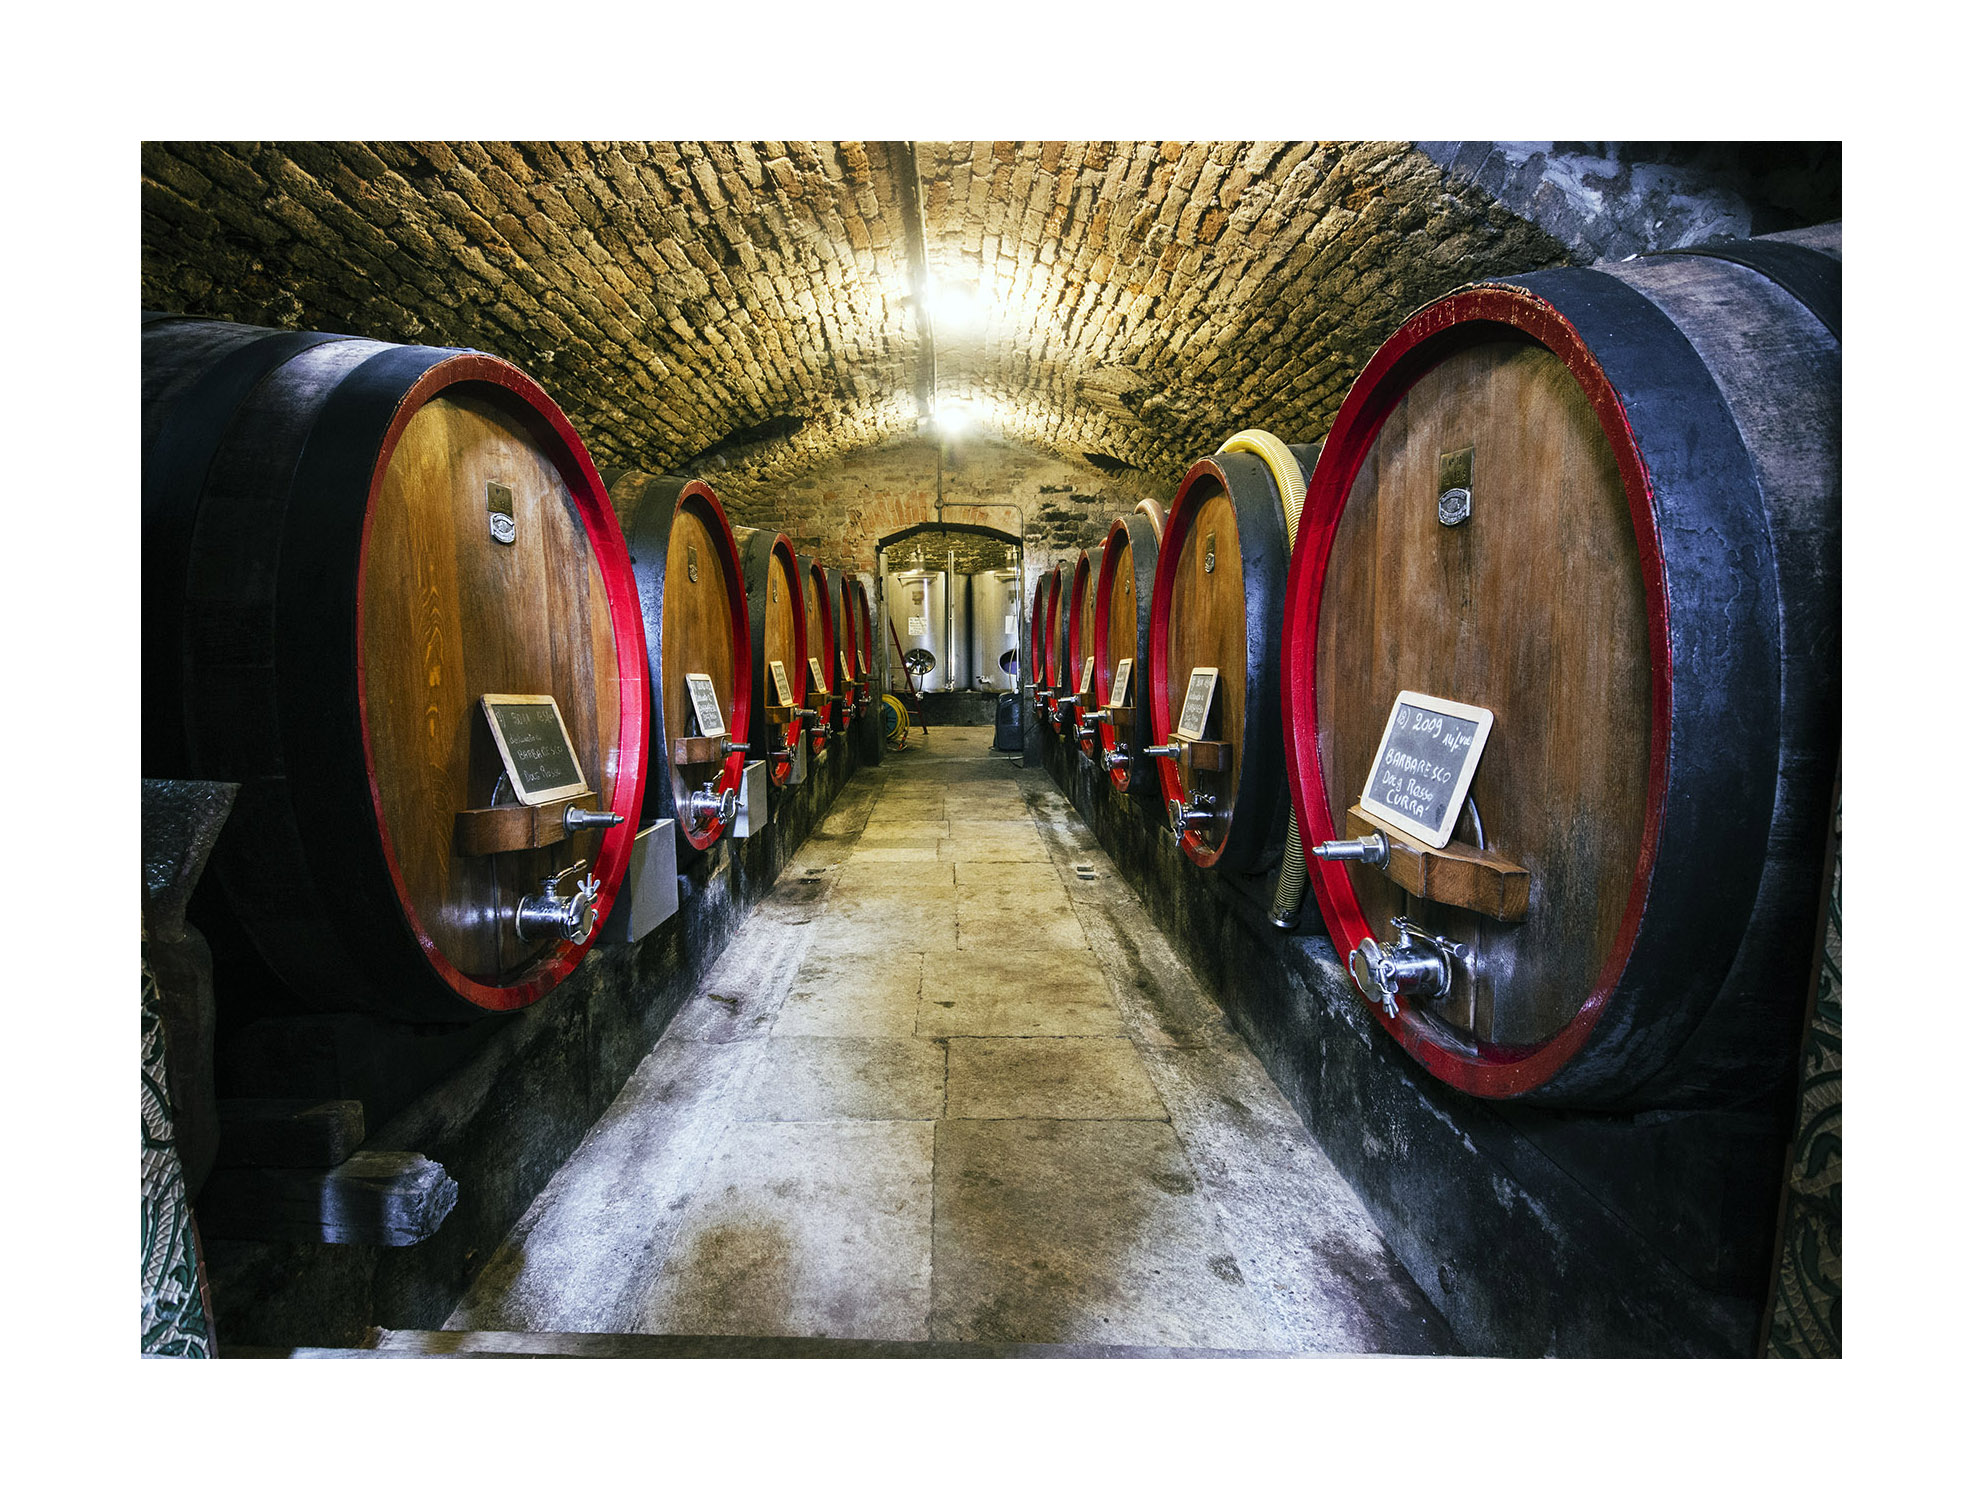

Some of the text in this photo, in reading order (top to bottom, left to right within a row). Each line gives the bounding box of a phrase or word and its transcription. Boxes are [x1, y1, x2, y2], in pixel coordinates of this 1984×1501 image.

[1412, 712, 1443, 738] 2009
[1385, 748, 1452, 784] BARBARESCO
[1406, 778, 1434, 802] Rosso
